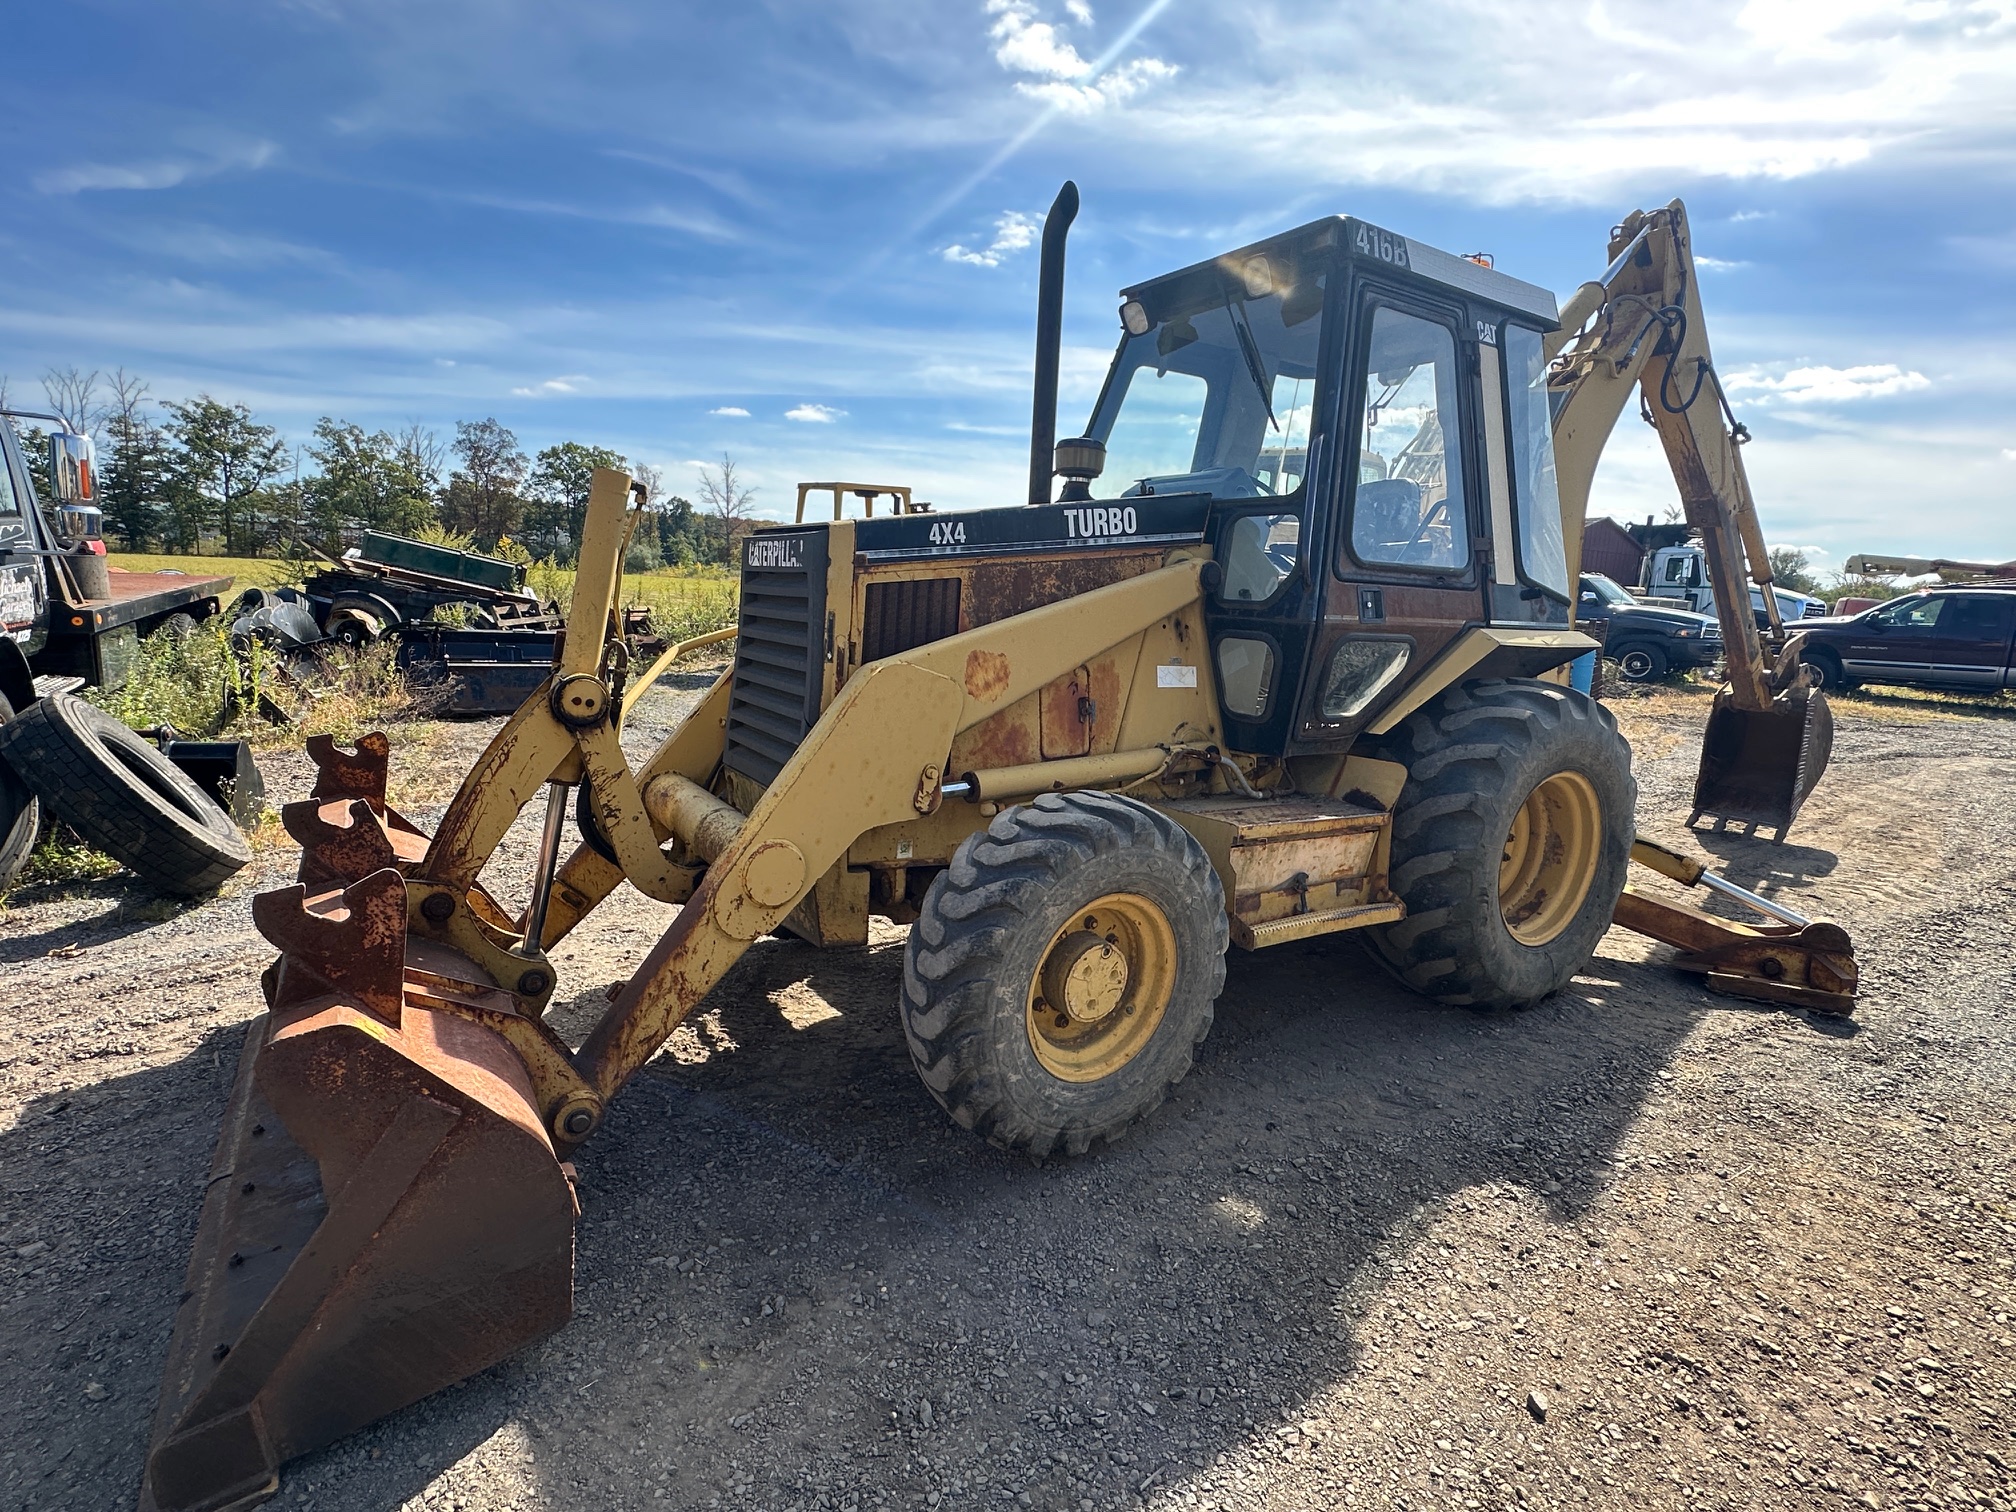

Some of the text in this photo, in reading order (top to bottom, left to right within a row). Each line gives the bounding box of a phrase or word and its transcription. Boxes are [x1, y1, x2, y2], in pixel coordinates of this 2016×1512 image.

[1356, 223, 1407, 267] 416B
[1477, 320, 1497, 345] CAT
[929, 522, 967, 545] 4X4
[1063, 506, 1137, 538] TURBO
[748, 539, 804, 567] CATERPILLA
